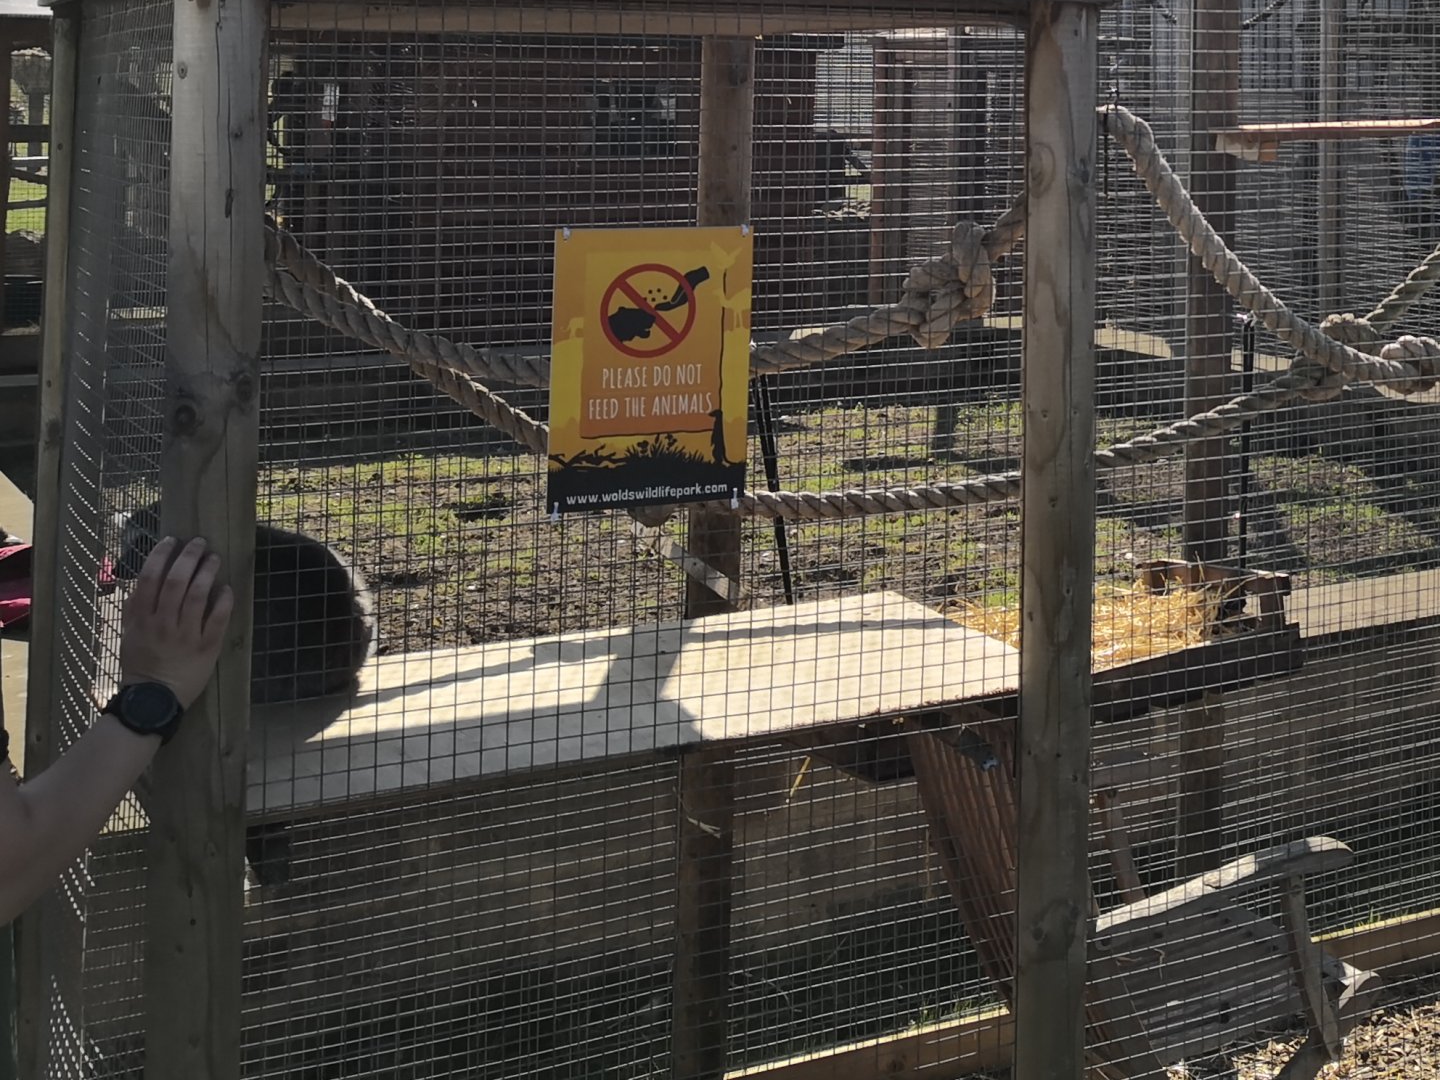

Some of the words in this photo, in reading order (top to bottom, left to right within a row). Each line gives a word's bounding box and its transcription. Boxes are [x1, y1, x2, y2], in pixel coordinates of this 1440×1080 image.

[602, 367, 647, 389] PLEASE
[653, 365, 671, 387] DO
[676, 364, 702, 385] NOT
[589, 398, 618, 420] FEED
[625, 396, 645, 418] THE
[651, 392, 713, 416] ANIMALS
[566, 483, 728, 506] www.woldswildlifepark.com
